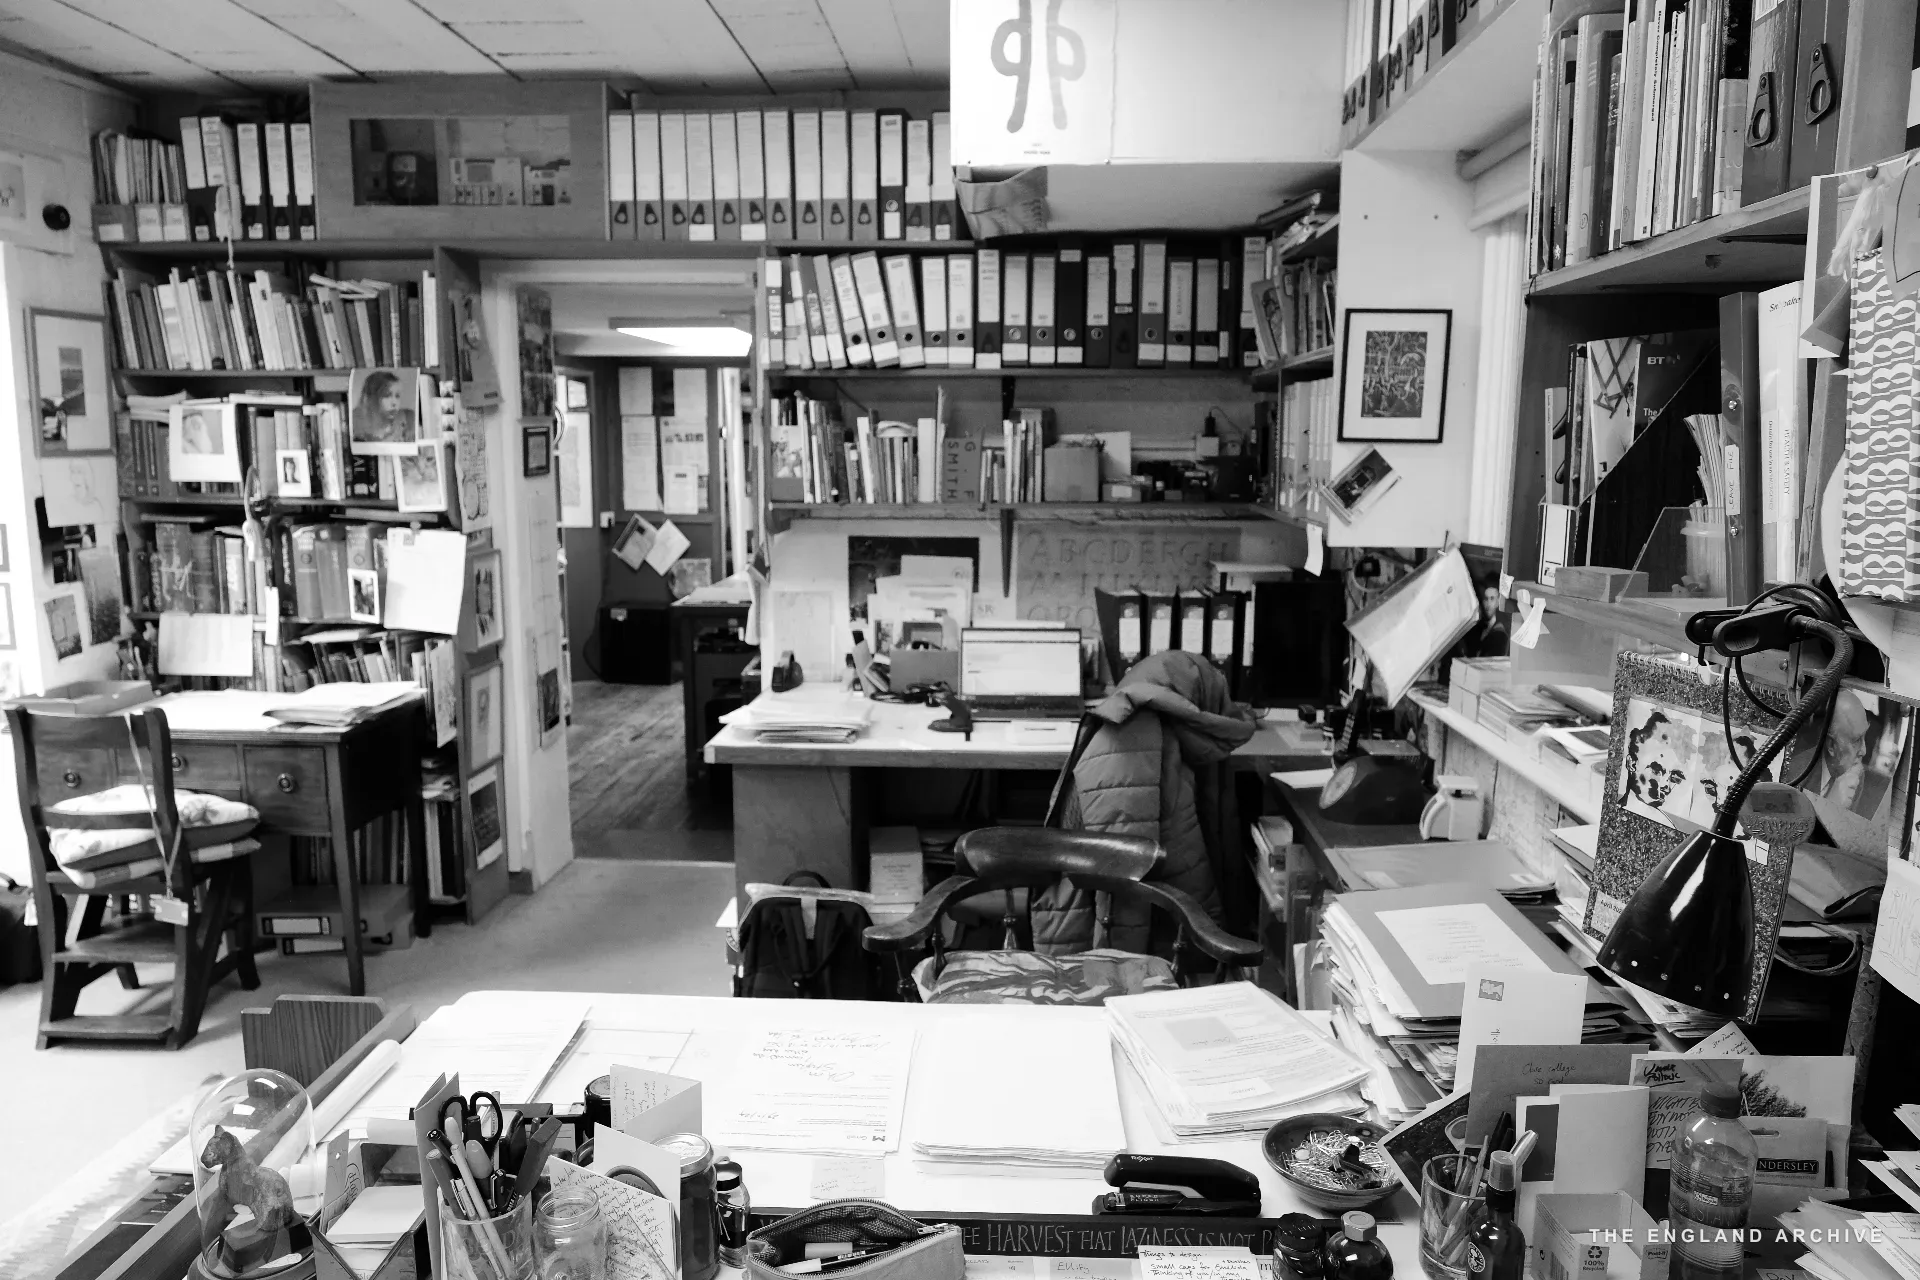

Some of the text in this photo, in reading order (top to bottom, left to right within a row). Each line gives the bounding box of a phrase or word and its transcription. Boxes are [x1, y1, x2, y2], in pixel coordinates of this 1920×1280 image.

[1647, 355, 1666, 365] BT
[1726, 450, 1735, 471] FILE
[947, 441, 959, 499] SMITH
[1601, 899, 1613, 910] April
[1759, 1160, 1816, 1171] NDERSLEY
[987, 1223, 1074, 1254] HARVEST
[1077, 1229, 1116, 1251] THAT
[1583, 1259, 1605, 1267] 100%
